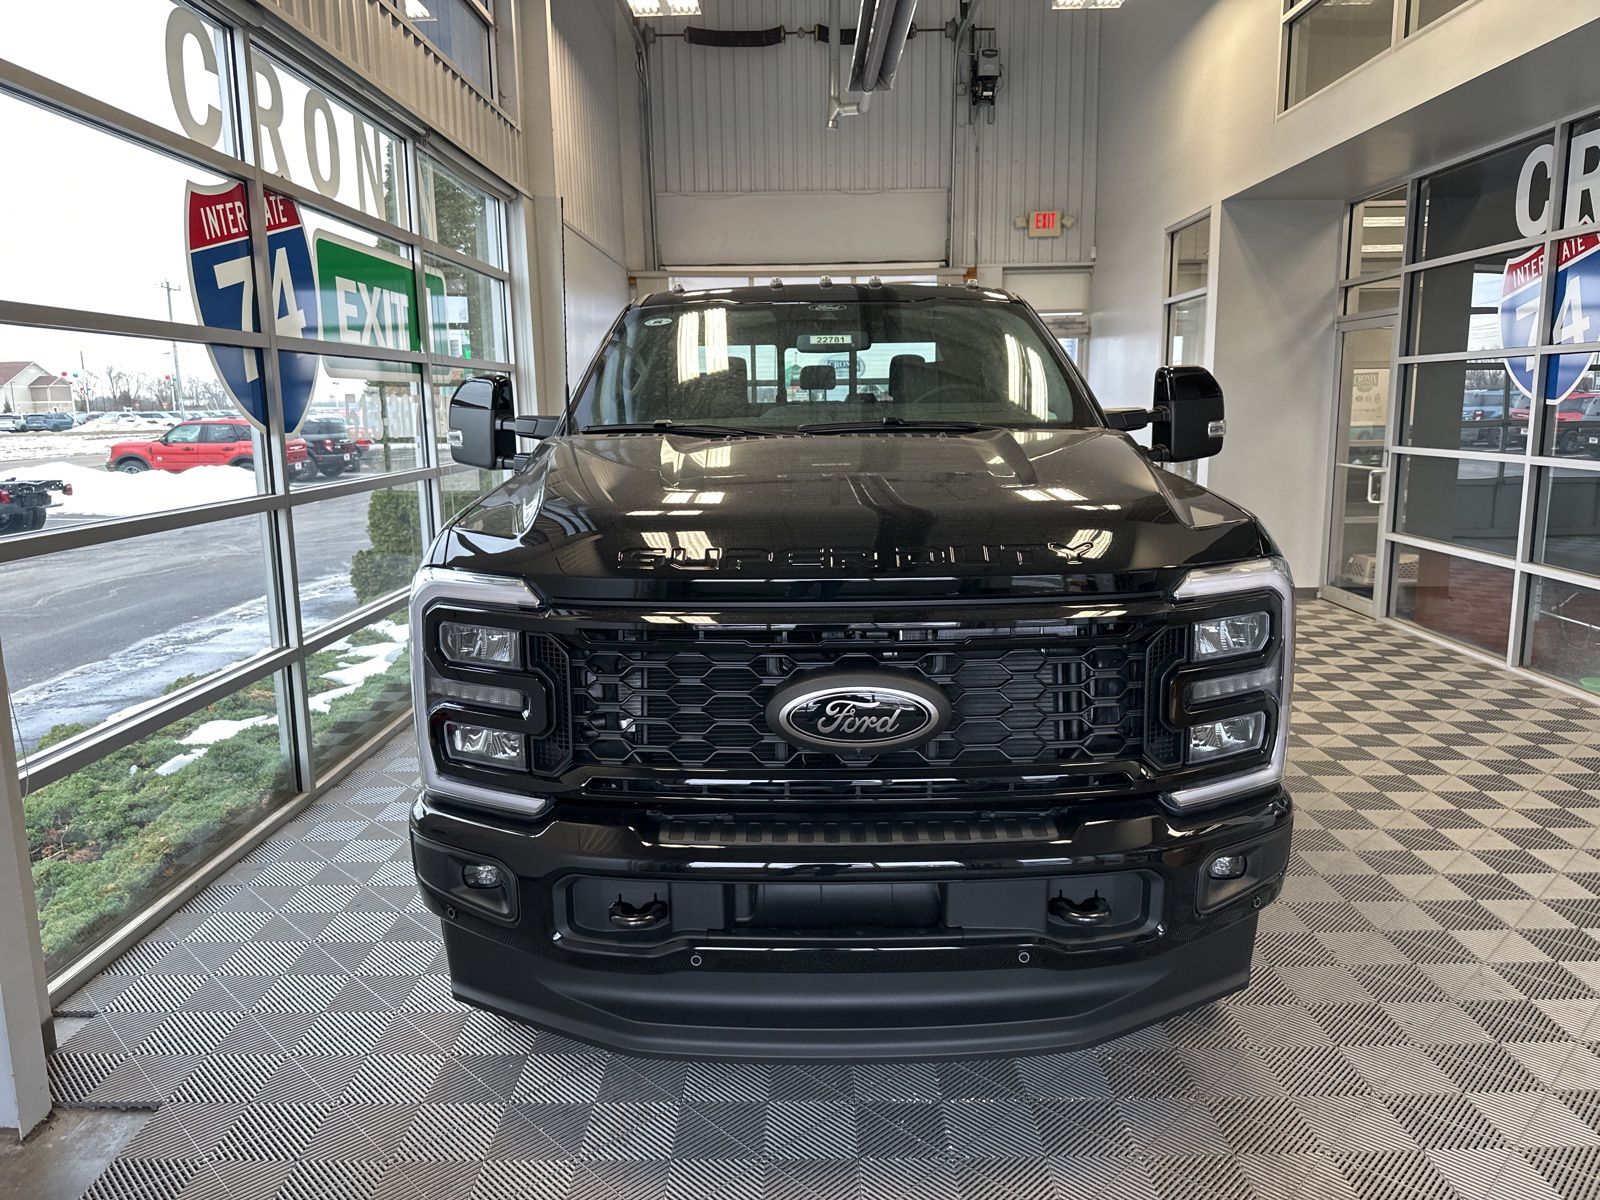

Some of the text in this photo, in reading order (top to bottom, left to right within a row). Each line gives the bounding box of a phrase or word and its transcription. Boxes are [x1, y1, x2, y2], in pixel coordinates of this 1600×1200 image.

[200, 195, 288, 241] INTERATE
[1035, 212, 1056, 229] EXIT
[1512, 235, 1586, 289] INTERATE
[213, 247, 307, 383] 74
[335, 275, 411, 352] EXIT
[1516, 276, 1591, 373] 74
[617, 541, 1094, 569] SUPER DUTY
[816, 700, 900, 733] Ford
